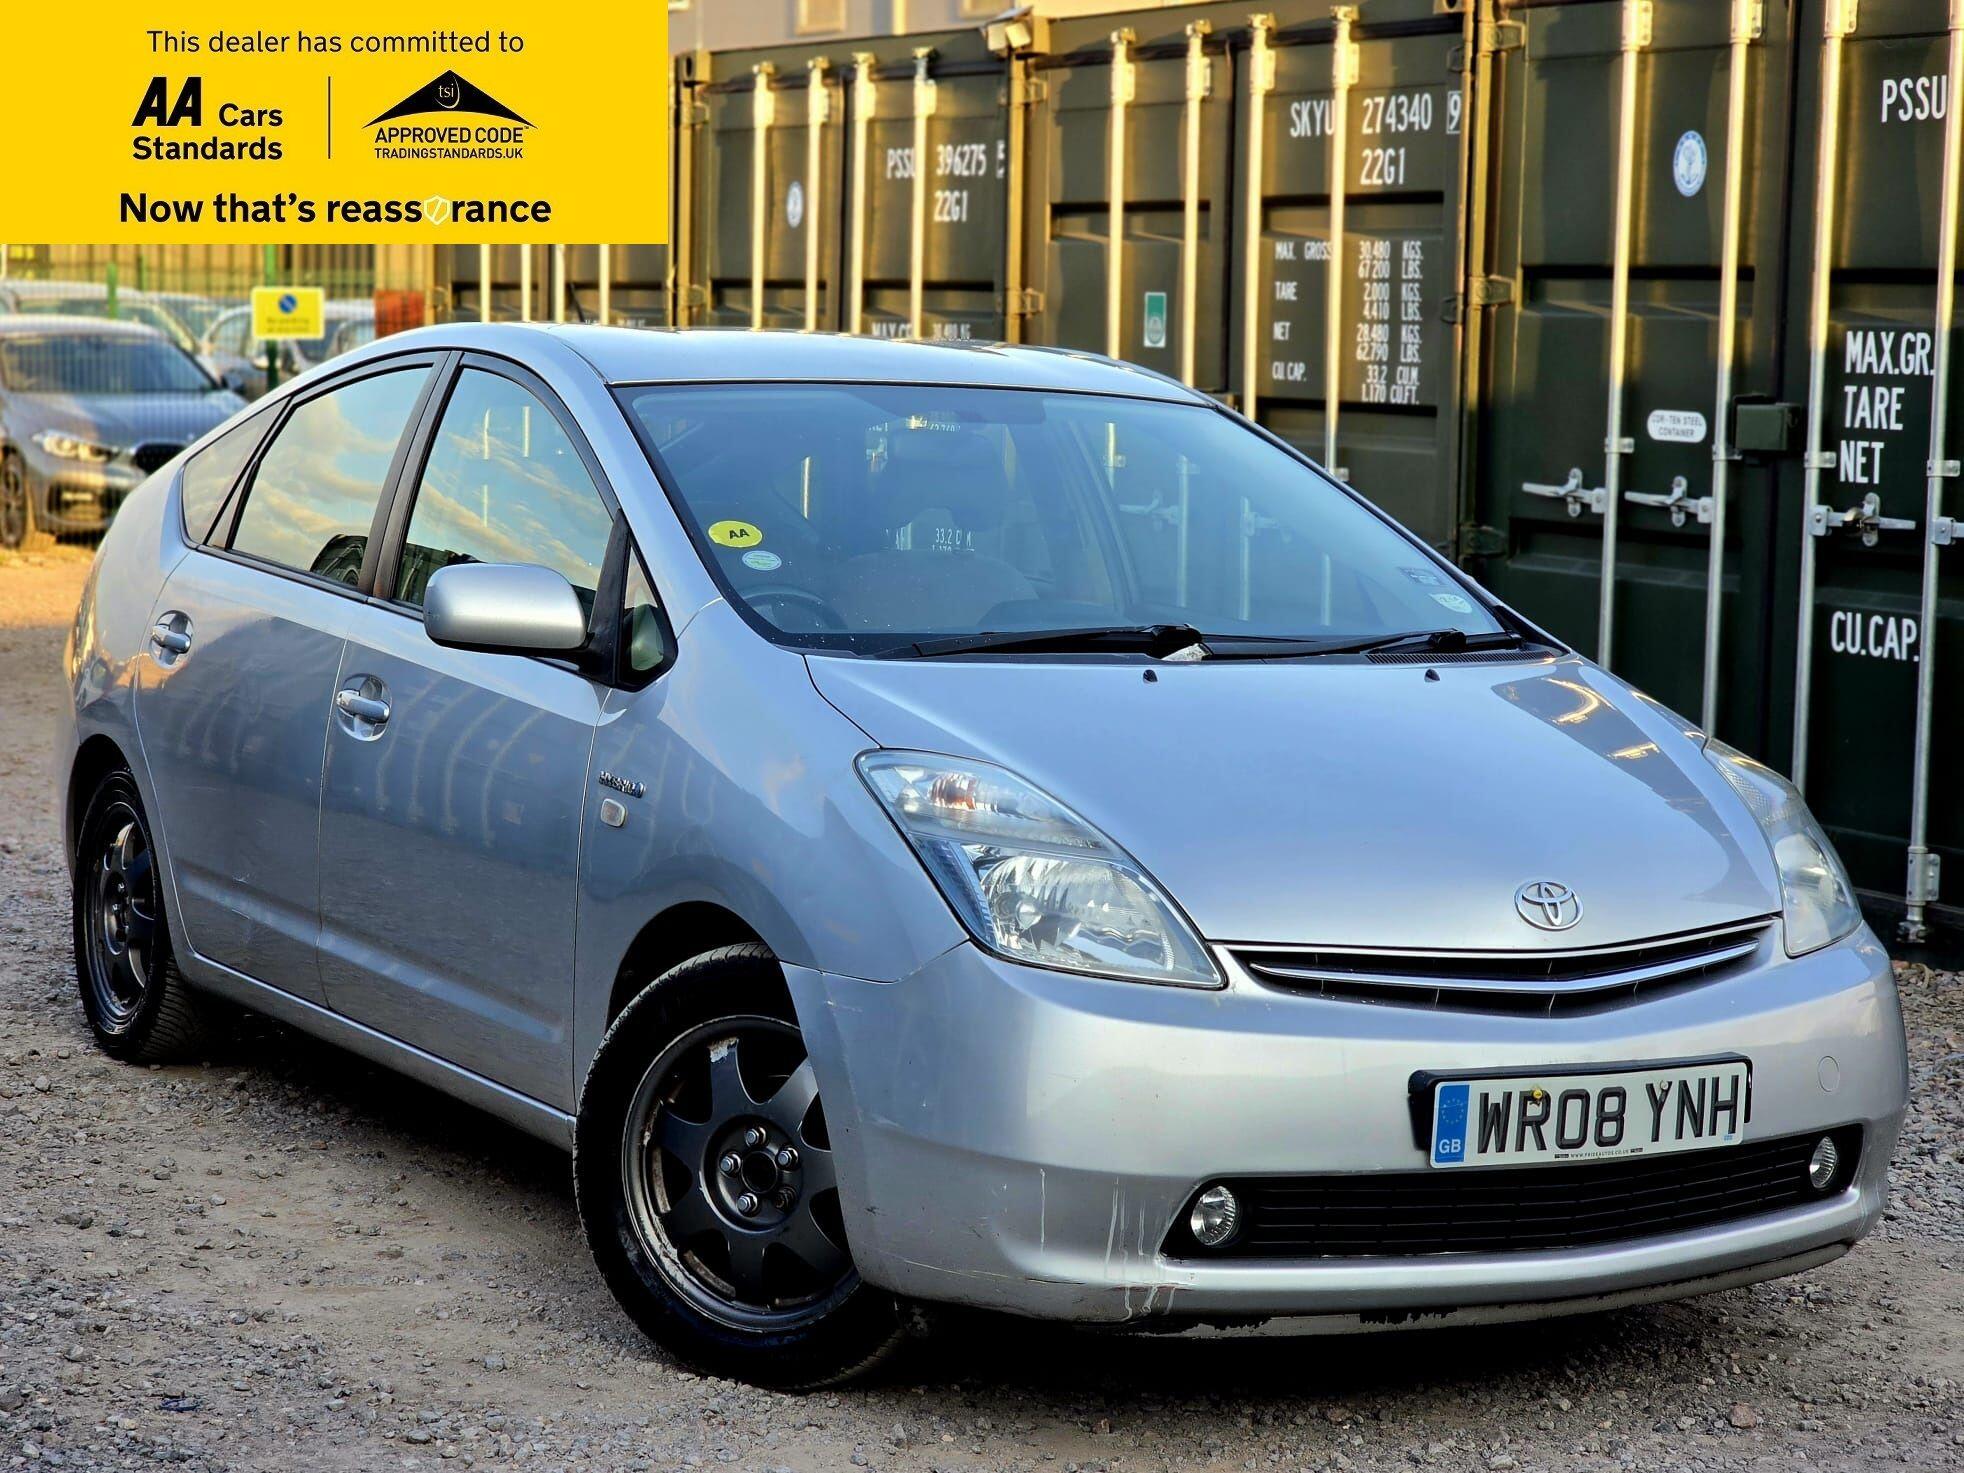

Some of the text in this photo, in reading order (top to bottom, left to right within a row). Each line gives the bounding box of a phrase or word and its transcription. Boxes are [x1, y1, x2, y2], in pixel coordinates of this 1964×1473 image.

[1289, 92, 1462, 138] SKYU 274340 9
[1881, 75, 1947, 123] PSSU
[936, 143, 987, 177] 396275
[1360, 147, 1405, 185] 22G1
[933, 189, 969, 222] 22G1
[1275, 281, 1298, 301] TARE
[1273, 321, 1291, 341] NET
[1845, 331, 1936, 376] MAX.GR.
[1844, 385, 1905, 430] TARE
[1839, 440, 1885, 484] NET
[729, 528, 750, 539] AA
[1831, 610, 1920, 662] CU.CAP.
[1645, 1074, 1739, 1143] YNH
[1439, 1138, 1461, 1154] GB
